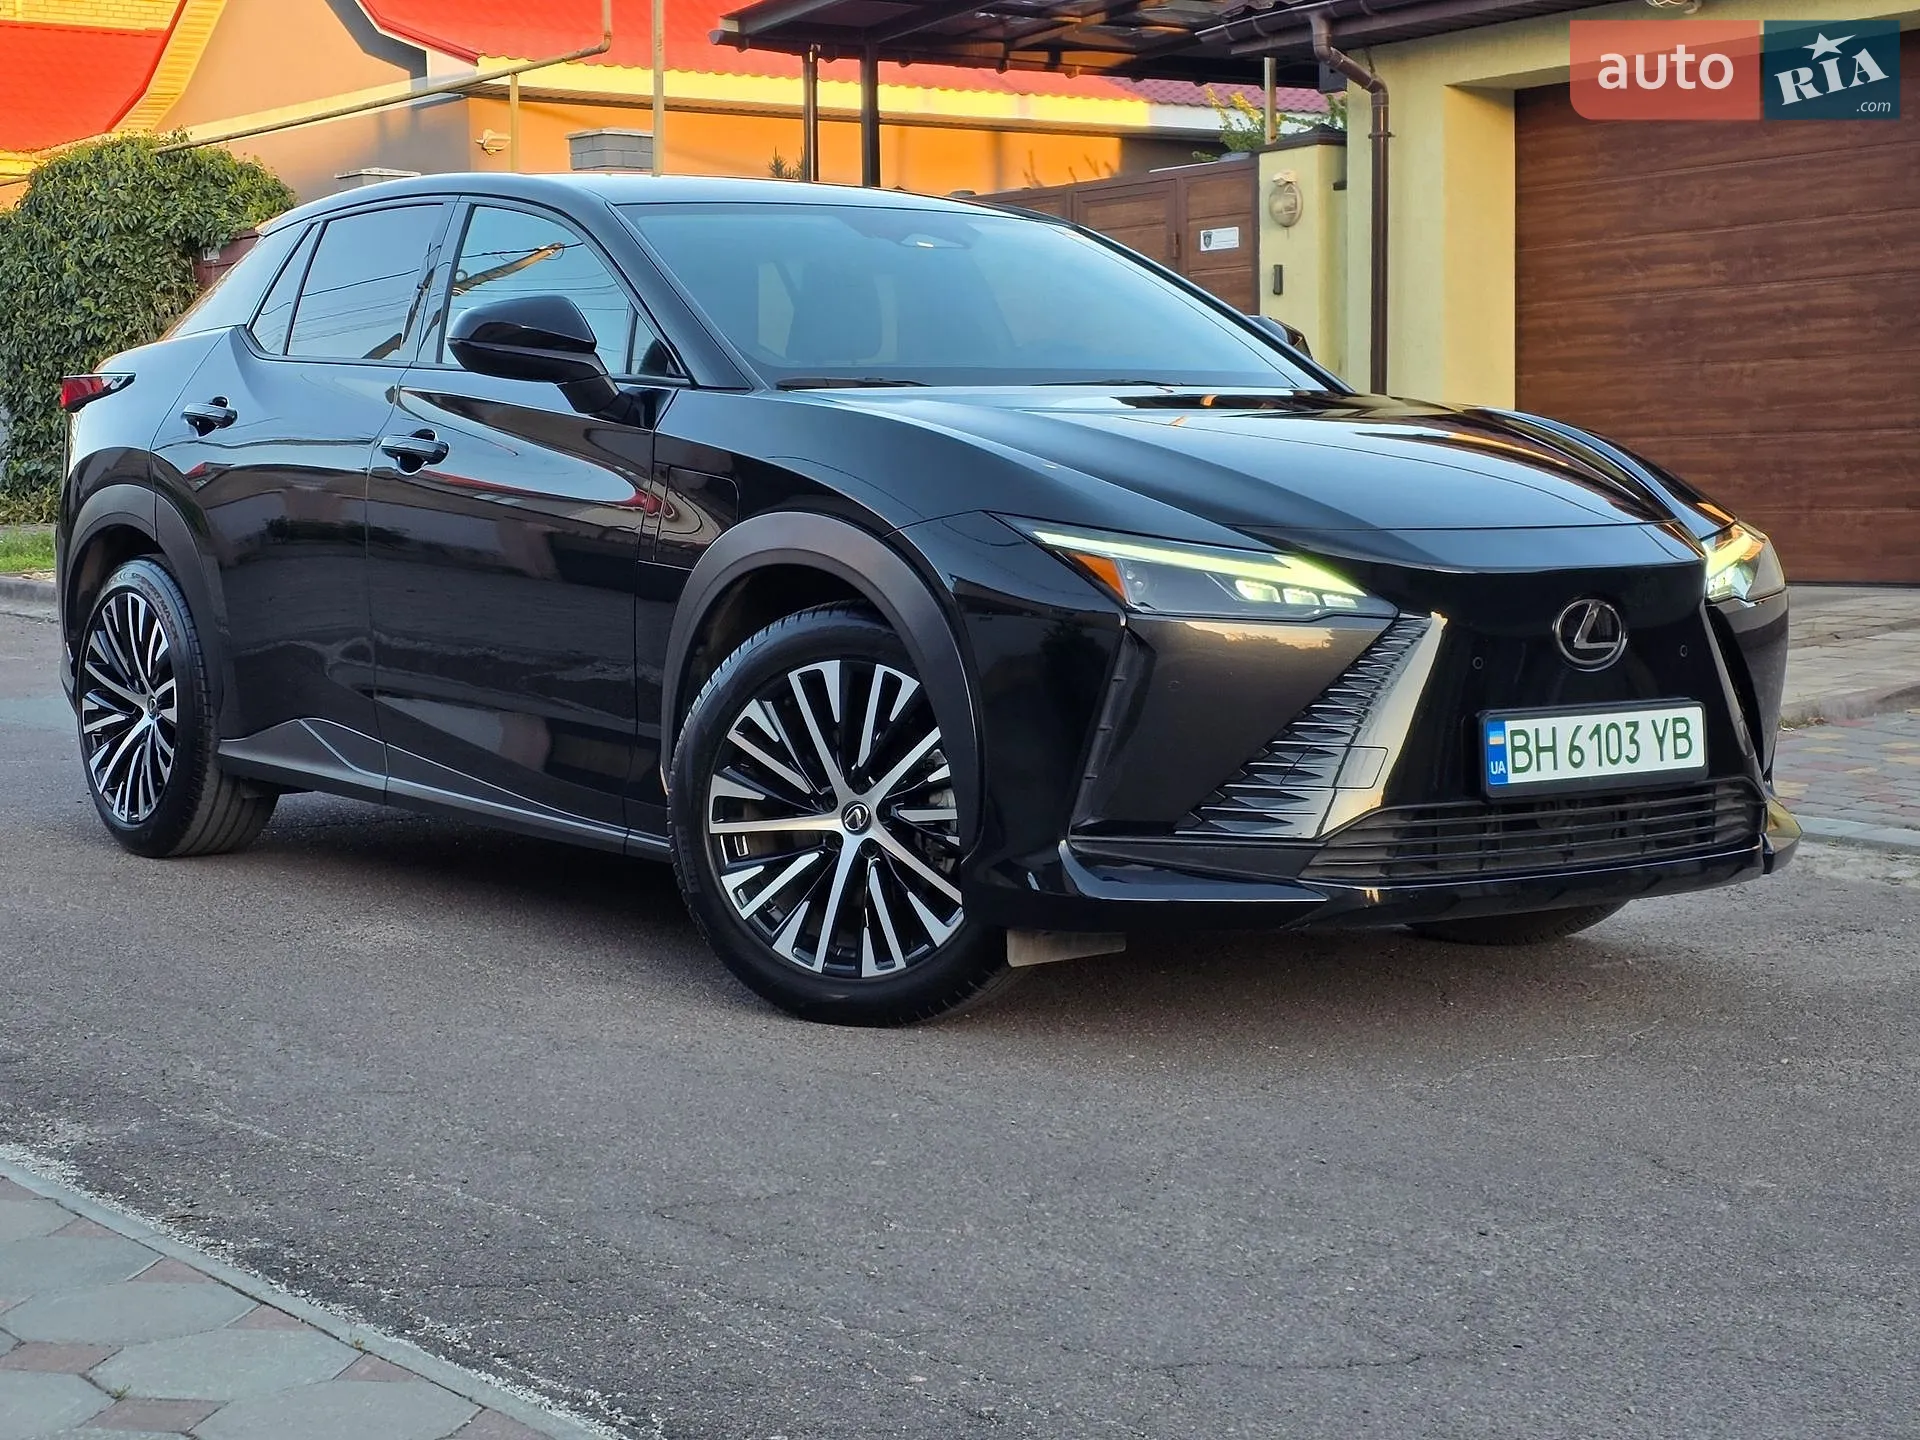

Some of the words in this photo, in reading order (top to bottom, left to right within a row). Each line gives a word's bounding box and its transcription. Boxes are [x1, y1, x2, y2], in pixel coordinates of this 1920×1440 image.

[1510, 726, 1558, 774] BH
[1568, 720, 1641, 769] 6103
[1651, 716, 1693, 762] YB
[1490, 760, 1506, 775] UA
